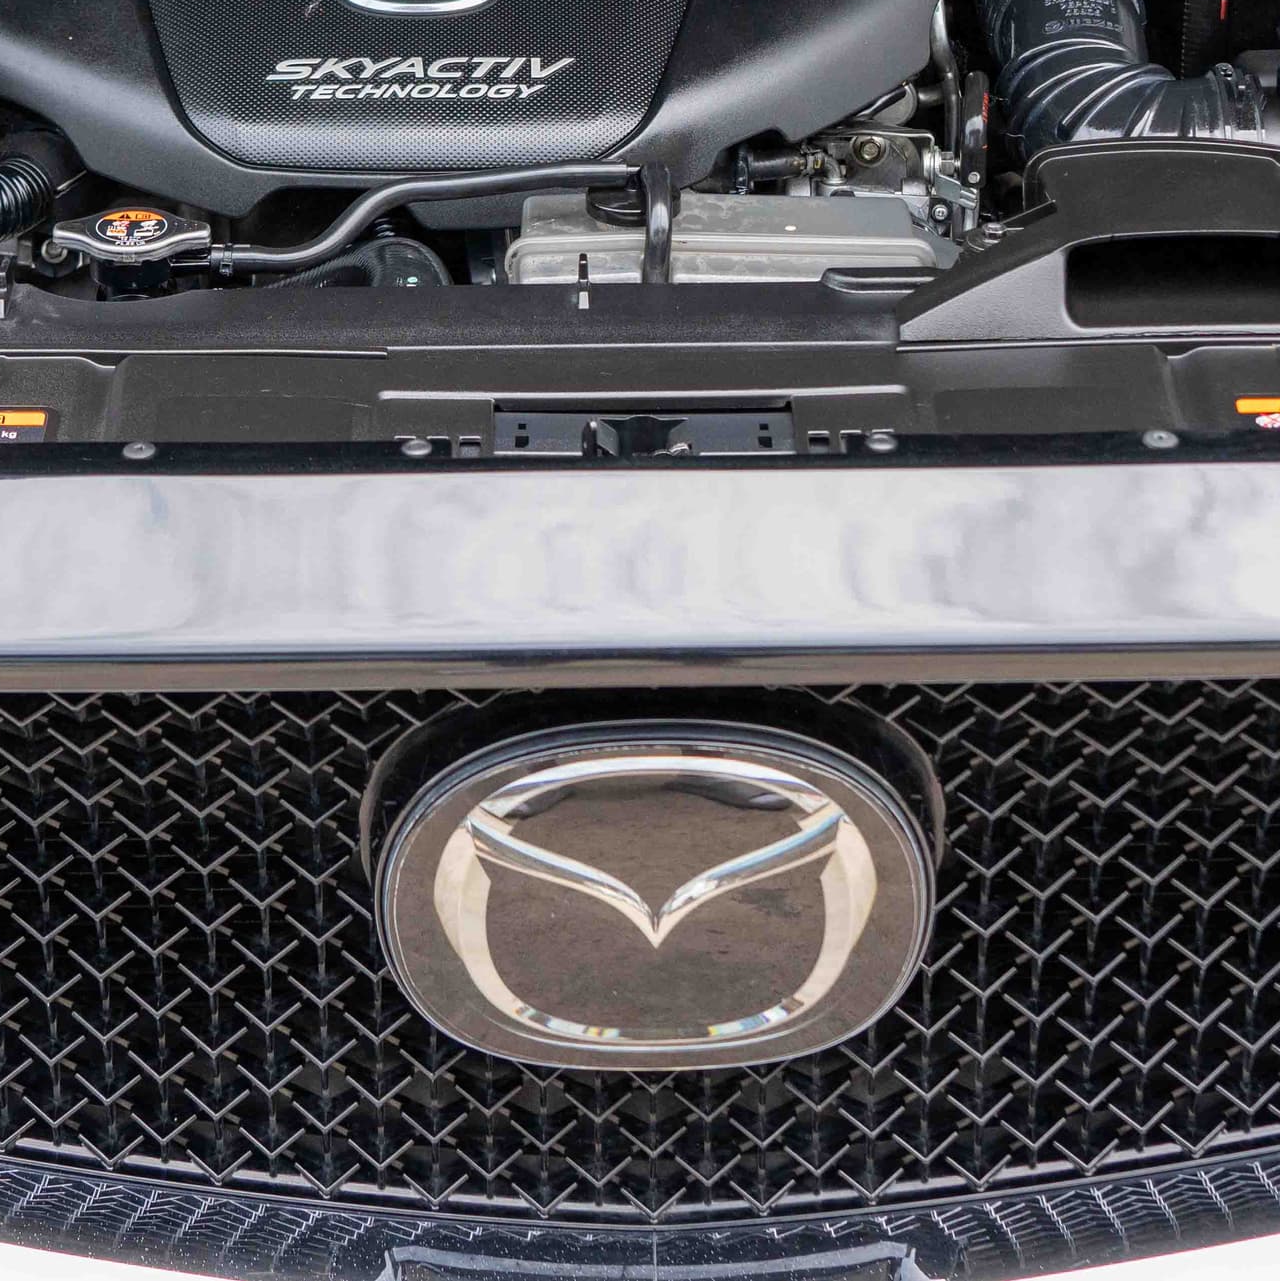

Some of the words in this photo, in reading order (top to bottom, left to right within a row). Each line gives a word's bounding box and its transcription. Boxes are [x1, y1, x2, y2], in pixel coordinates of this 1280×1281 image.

[266, 56, 576, 82] SKYACTIV
[290, 83, 547, 102] TECHNOLOGY
[1, 430, 18, 440] kg
